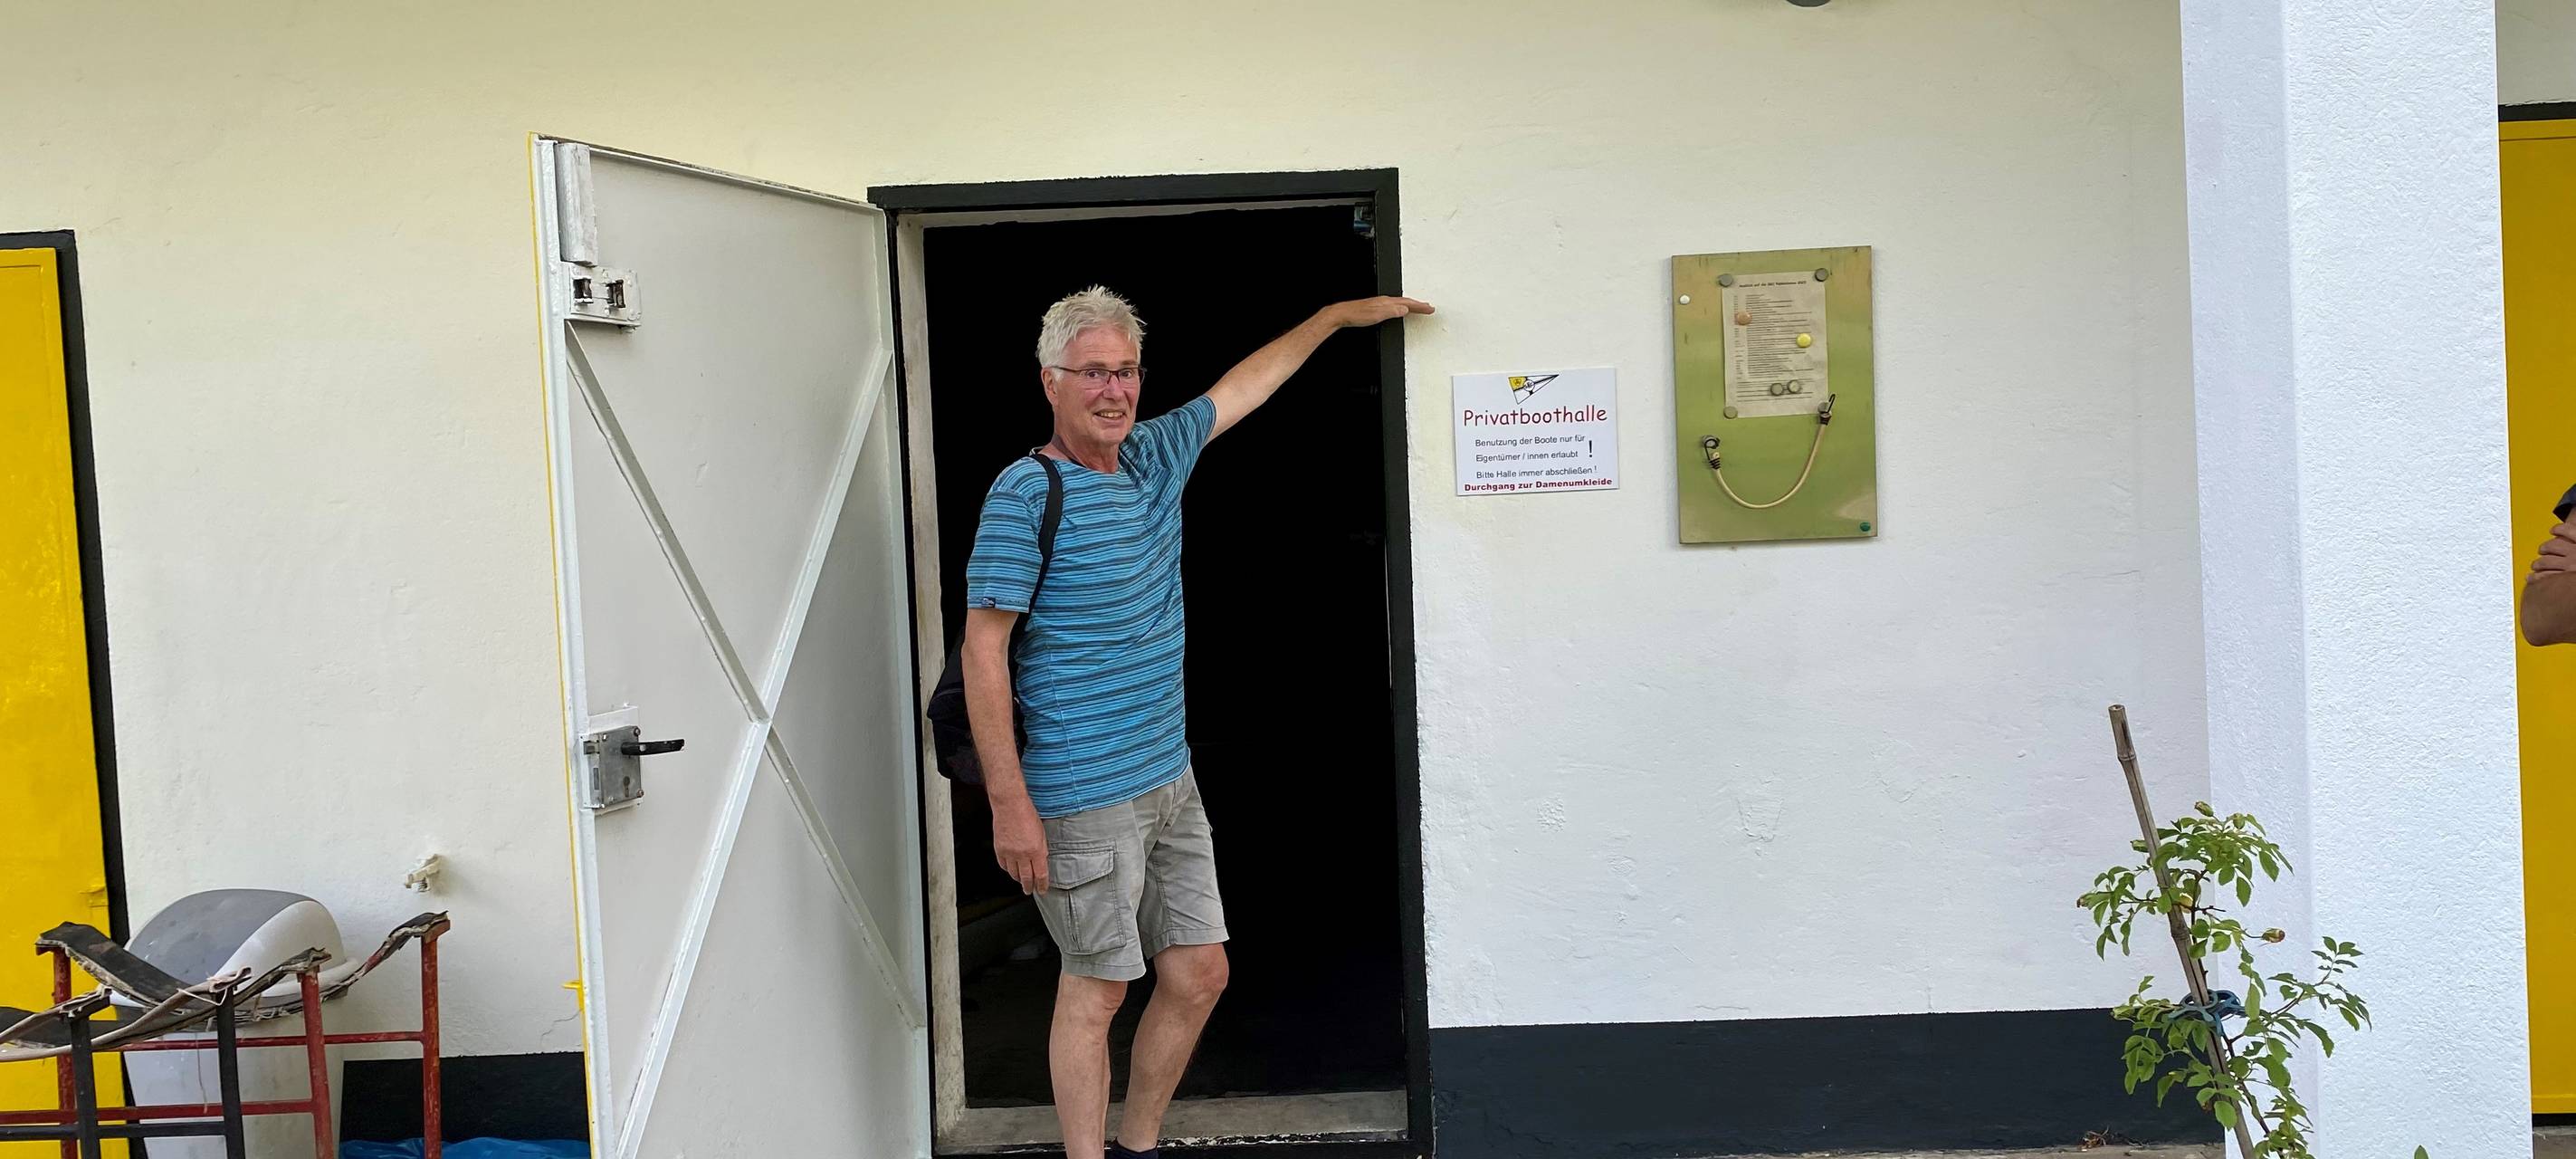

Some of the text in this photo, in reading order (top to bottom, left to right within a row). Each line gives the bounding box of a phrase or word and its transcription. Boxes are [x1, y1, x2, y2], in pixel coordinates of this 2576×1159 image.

[1464, 405, 1608, 426] Privatboothalle
[1589, 440, 1593, 457] !
[1476, 454, 1521, 463] Eigentümer
[1496, 470, 1517, 478] Halle
[1545, 466, 1593, 475] abschließen
[1465, 483, 1515, 492] Durchgang
[1536, 478, 1612, 488] Damenumkleide
